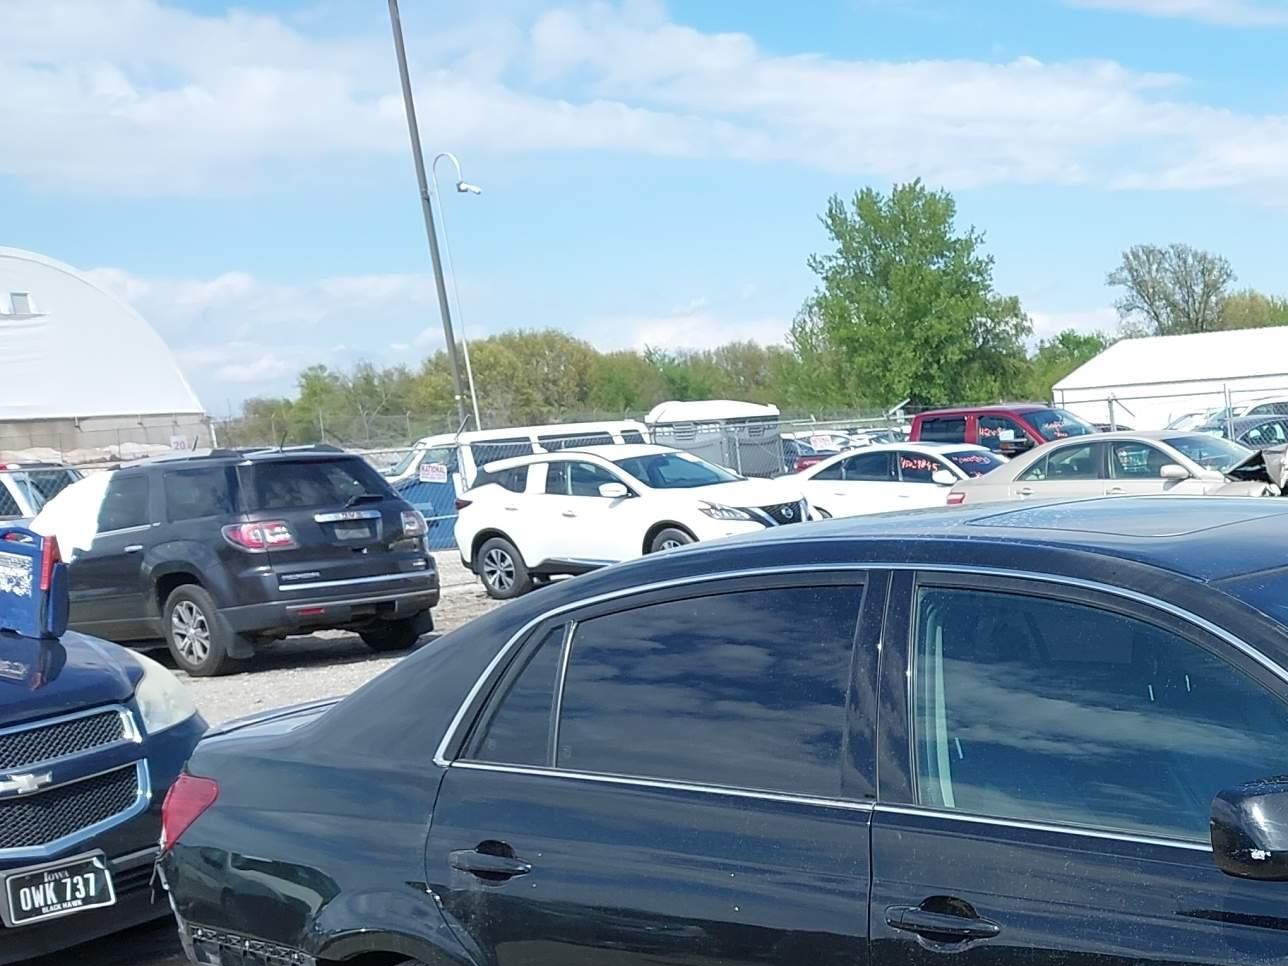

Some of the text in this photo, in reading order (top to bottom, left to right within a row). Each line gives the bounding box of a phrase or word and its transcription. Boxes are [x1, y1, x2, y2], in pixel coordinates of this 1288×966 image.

[20, 873, 96, 911] OWK 737
[42, 899, 83, 914] BLACK HAWK
